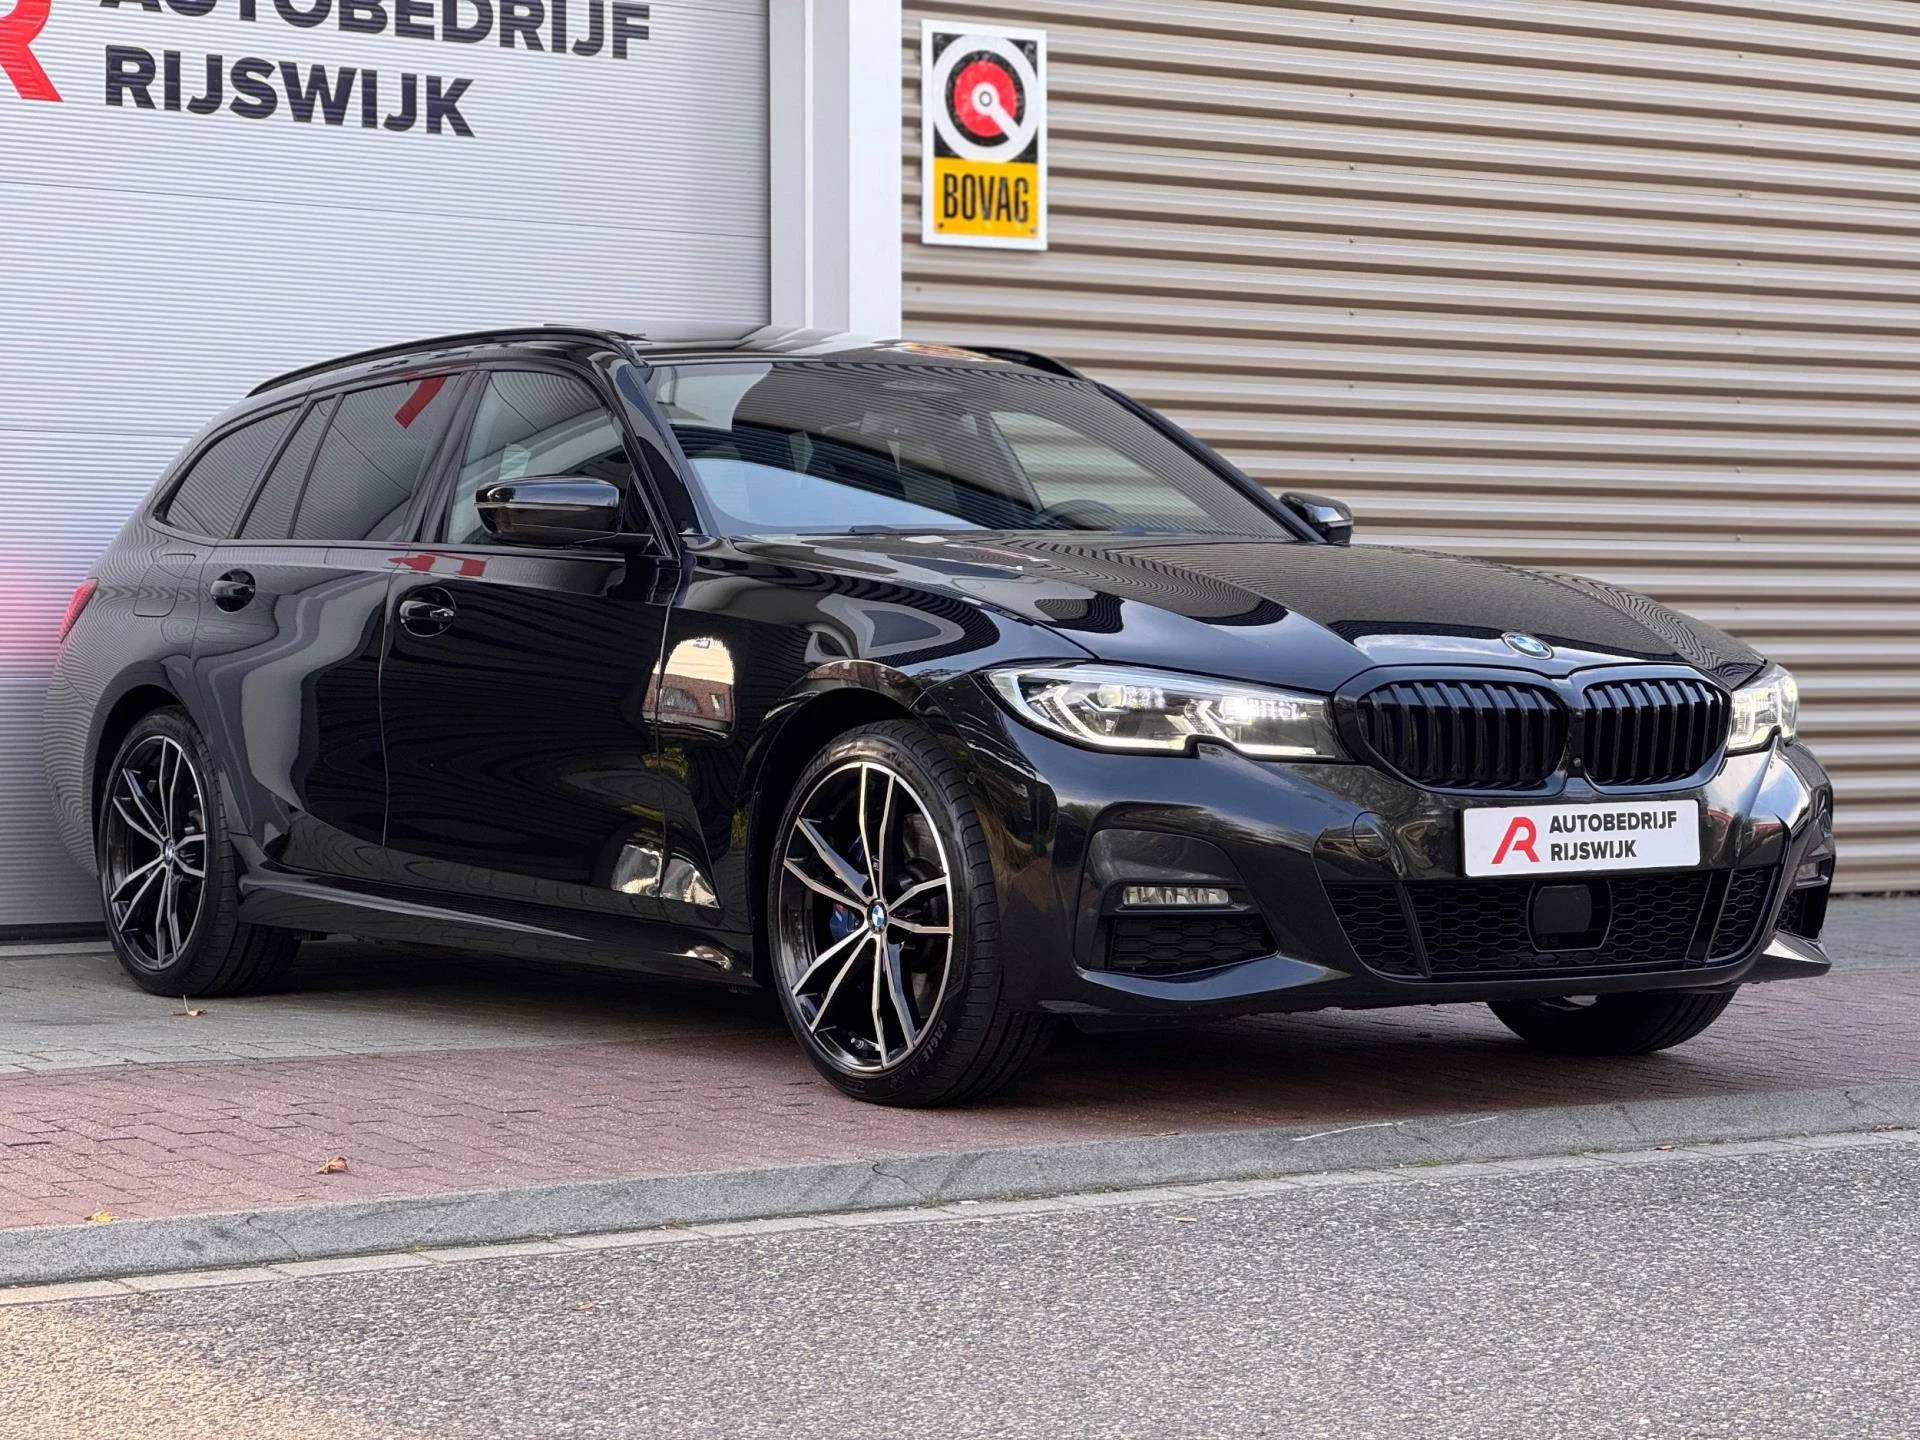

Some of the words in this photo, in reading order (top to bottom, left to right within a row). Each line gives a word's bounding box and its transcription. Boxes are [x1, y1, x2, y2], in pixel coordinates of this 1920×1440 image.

[98, 0, 651, 60] BEDRIJF
[104, 44, 475, 138] RIJSWIJK
[943, 172, 1029, 223] BOVAG
[1549, 810, 1678, 834] AUTOBEDRIJF
[1550, 839, 1637, 862] RIJSWIJK
